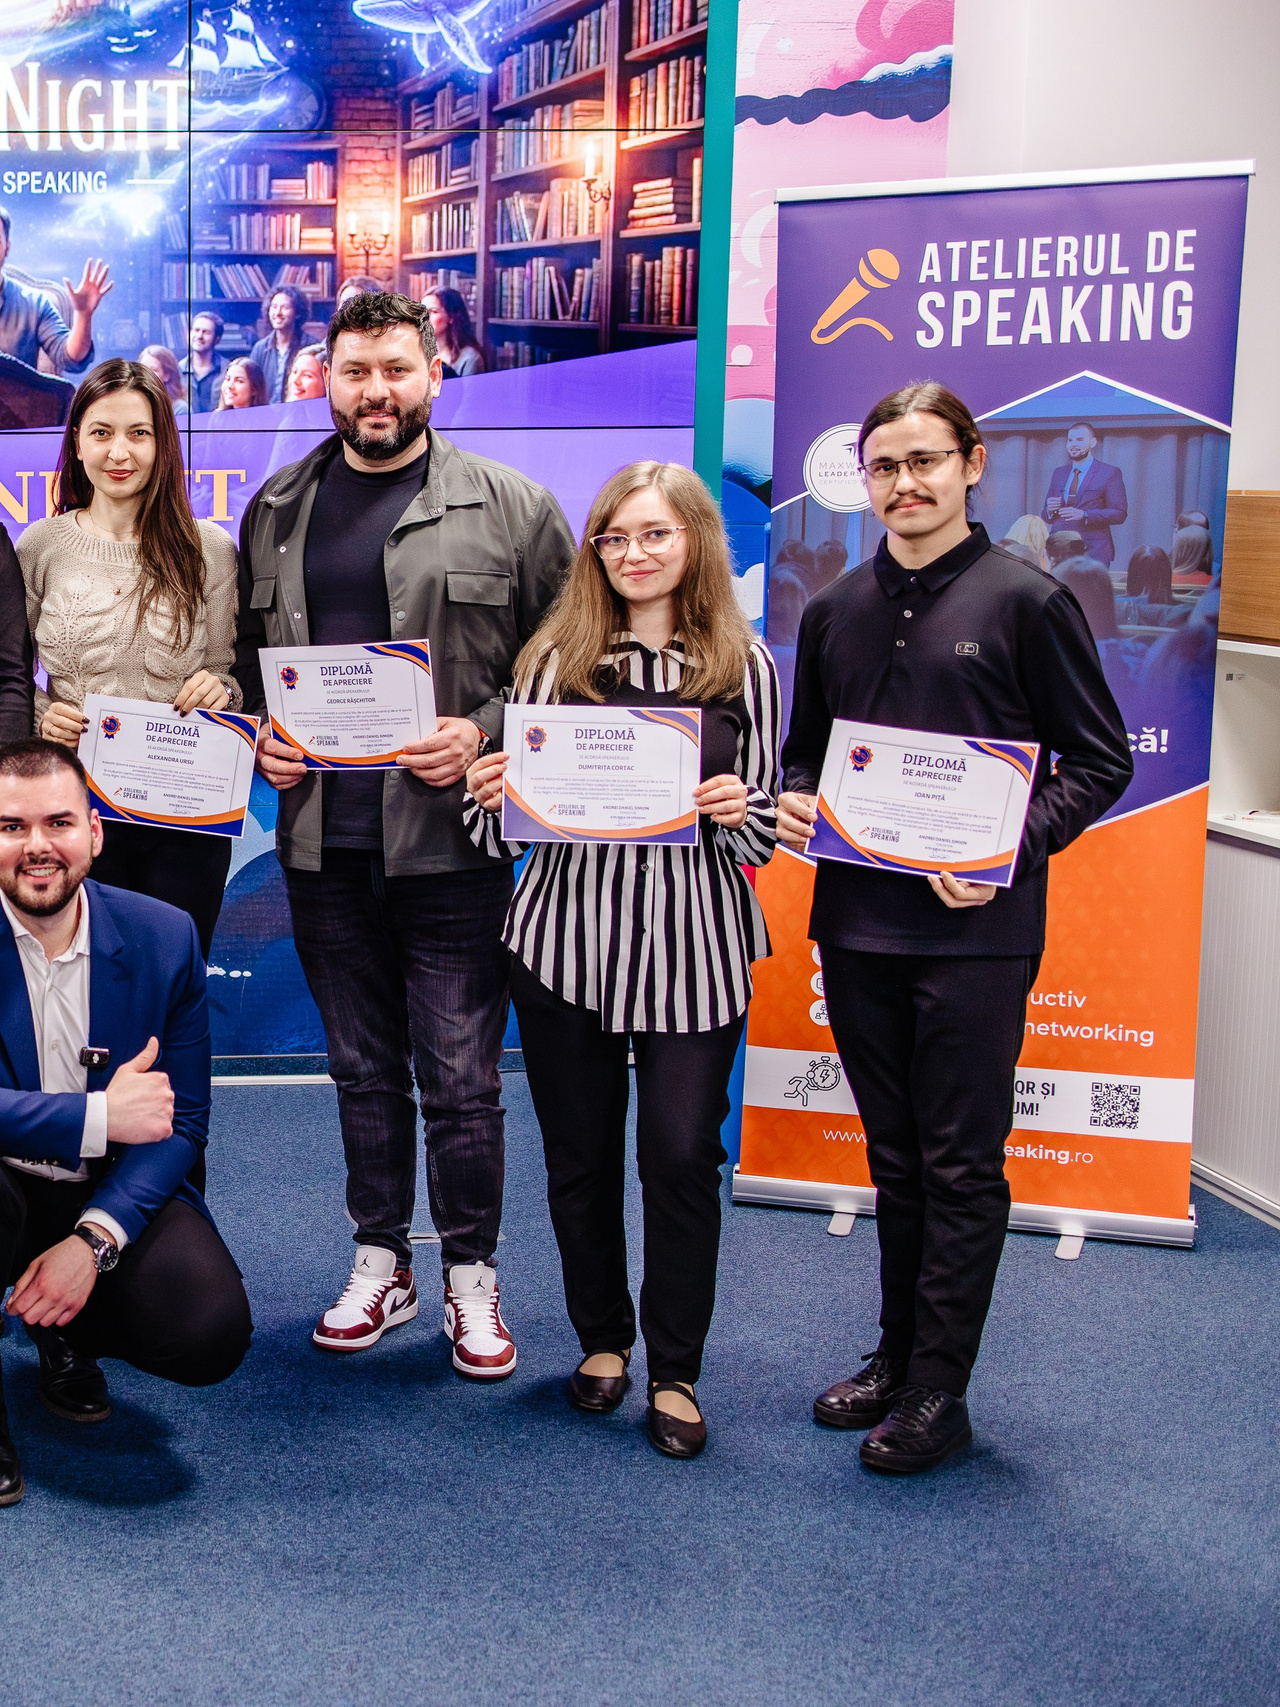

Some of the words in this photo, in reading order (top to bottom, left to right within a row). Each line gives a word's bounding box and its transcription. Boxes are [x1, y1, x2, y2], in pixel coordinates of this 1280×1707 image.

[2, 170, 108, 194] SPEAKING
[918, 232, 1130, 284] ATELIERUL
[1146, 229, 1198, 273] DE
[915, 280, 1194, 349] SPEAKING
[319, 661, 373, 676] DIPLOMĂ
[332, 677, 372, 685] APRECIERE
[145, 721, 200, 738] DIPLOMĂ
[574, 727, 636, 740] DIPLOMĂ
[145, 734, 156, 742] DE
[156, 735, 197, 747] APRECIERE
[576, 742, 587, 750] DE
[588, 743, 634, 751] APRECIERE
[147, 753, 179, 763] ALEXANDRA
[902, 752, 967, 772] DIPLOMĂ
[901, 767, 914, 776] DE
[914, 769, 963, 783] APRECIERE
[122, 791, 148, 801] SPEAKING
[913, 791, 931, 799] IOAN
[869, 832, 899, 842] SPEAKING
[1030, 990, 1087, 1008] uctiv
[1023, 1020, 1155, 1047] networking
[1014, 1080, 1036, 1095] QR
